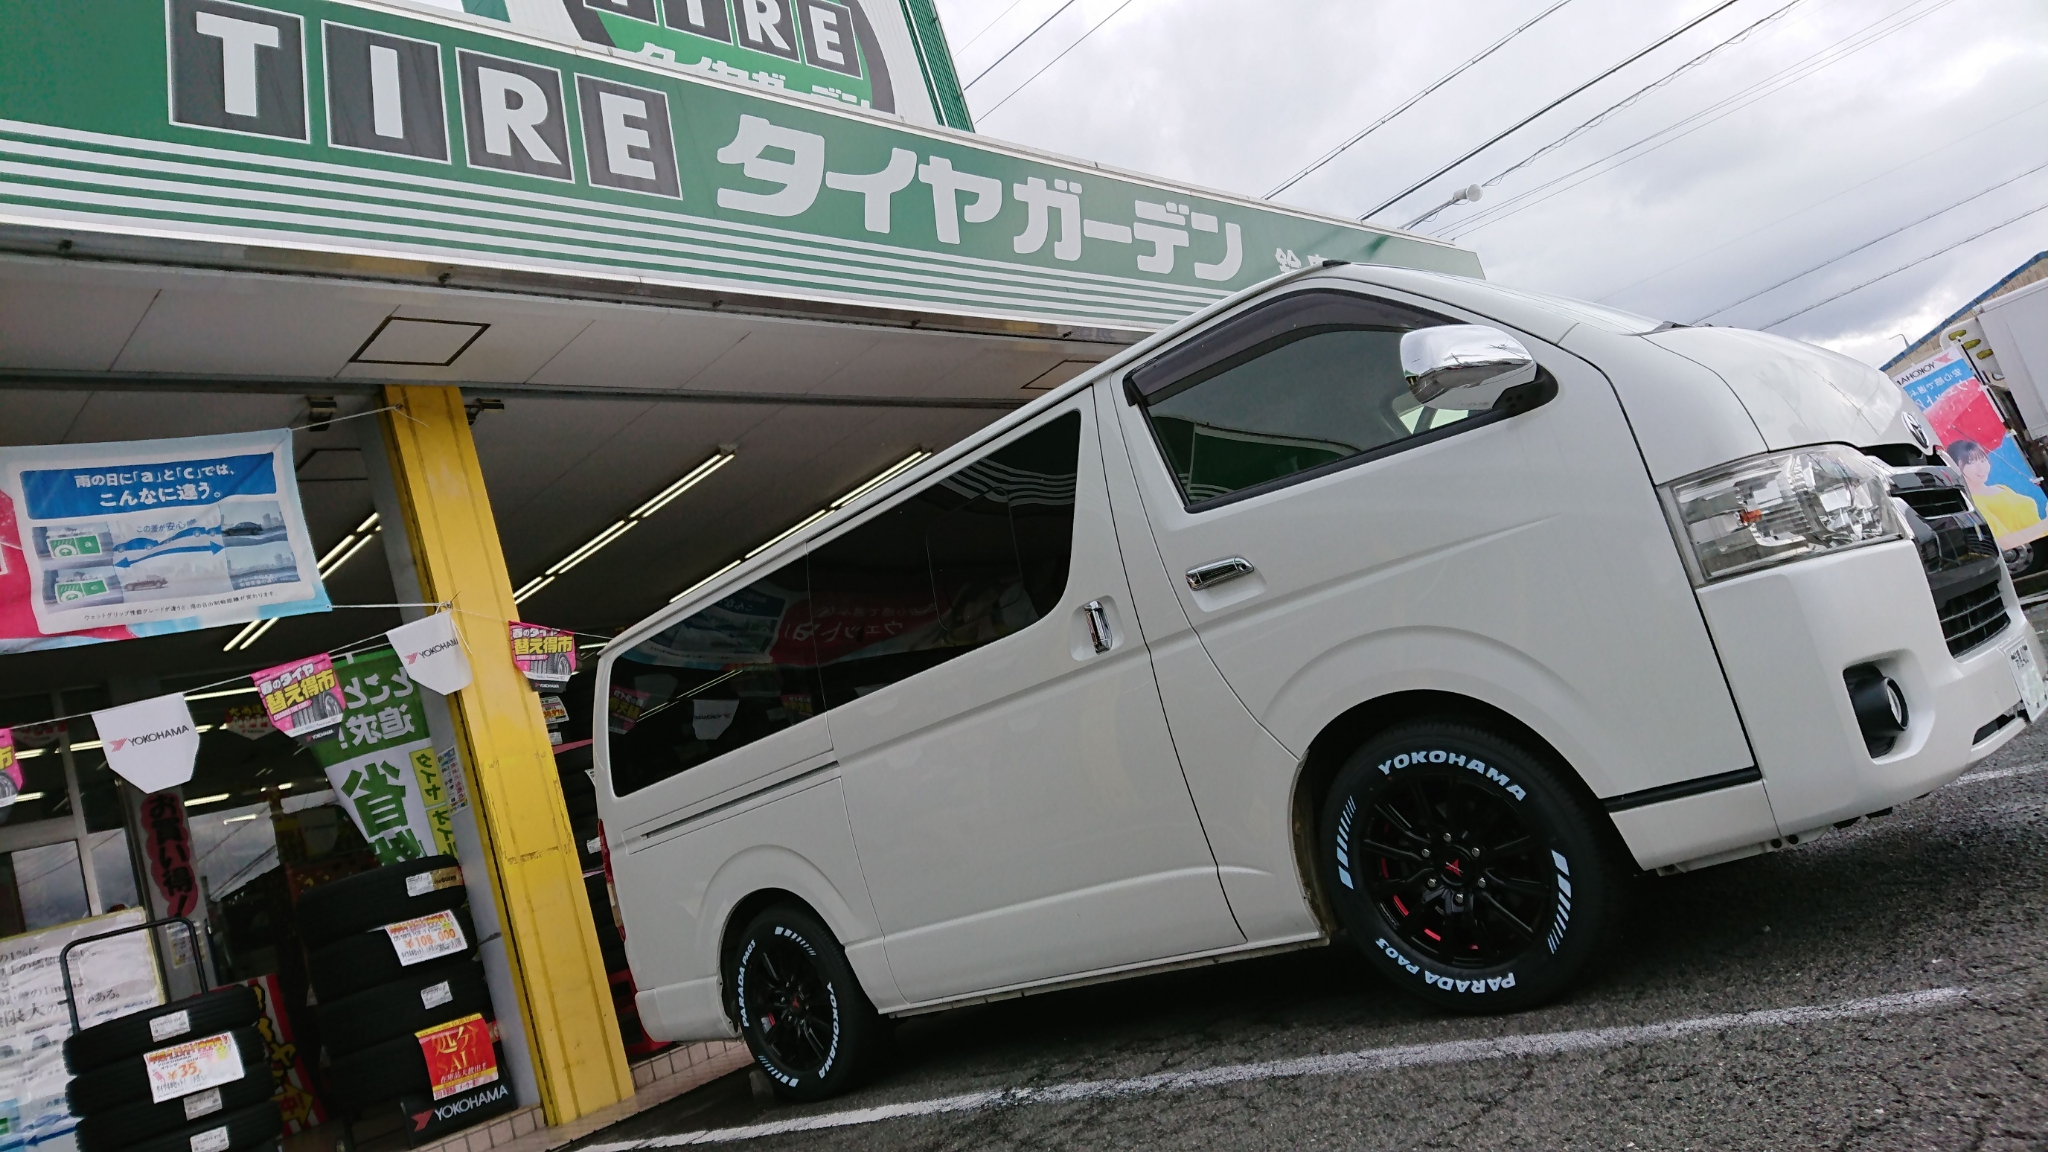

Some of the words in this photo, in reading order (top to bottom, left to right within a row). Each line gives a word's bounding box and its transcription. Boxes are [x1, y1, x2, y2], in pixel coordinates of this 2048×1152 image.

[197, 11, 655, 180] TIRE
[716, 114, 1243, 282] タイヤガーデン
[419, 638, 458, 658] YOKOHAM
[128, 724, 189, 747] YOKOHAMA
[1377, 750, 1526, 801] YOKOHAMA
[1375, 937, 1420, 975] PA03
[737, 967, 750, 1027] PARADA
[1424, 972, 1517, 993] PARADA
[818, 982, 841, 1079] YOKOHAMA
[435, 1085, 508, 1121] YOKOHAMA
